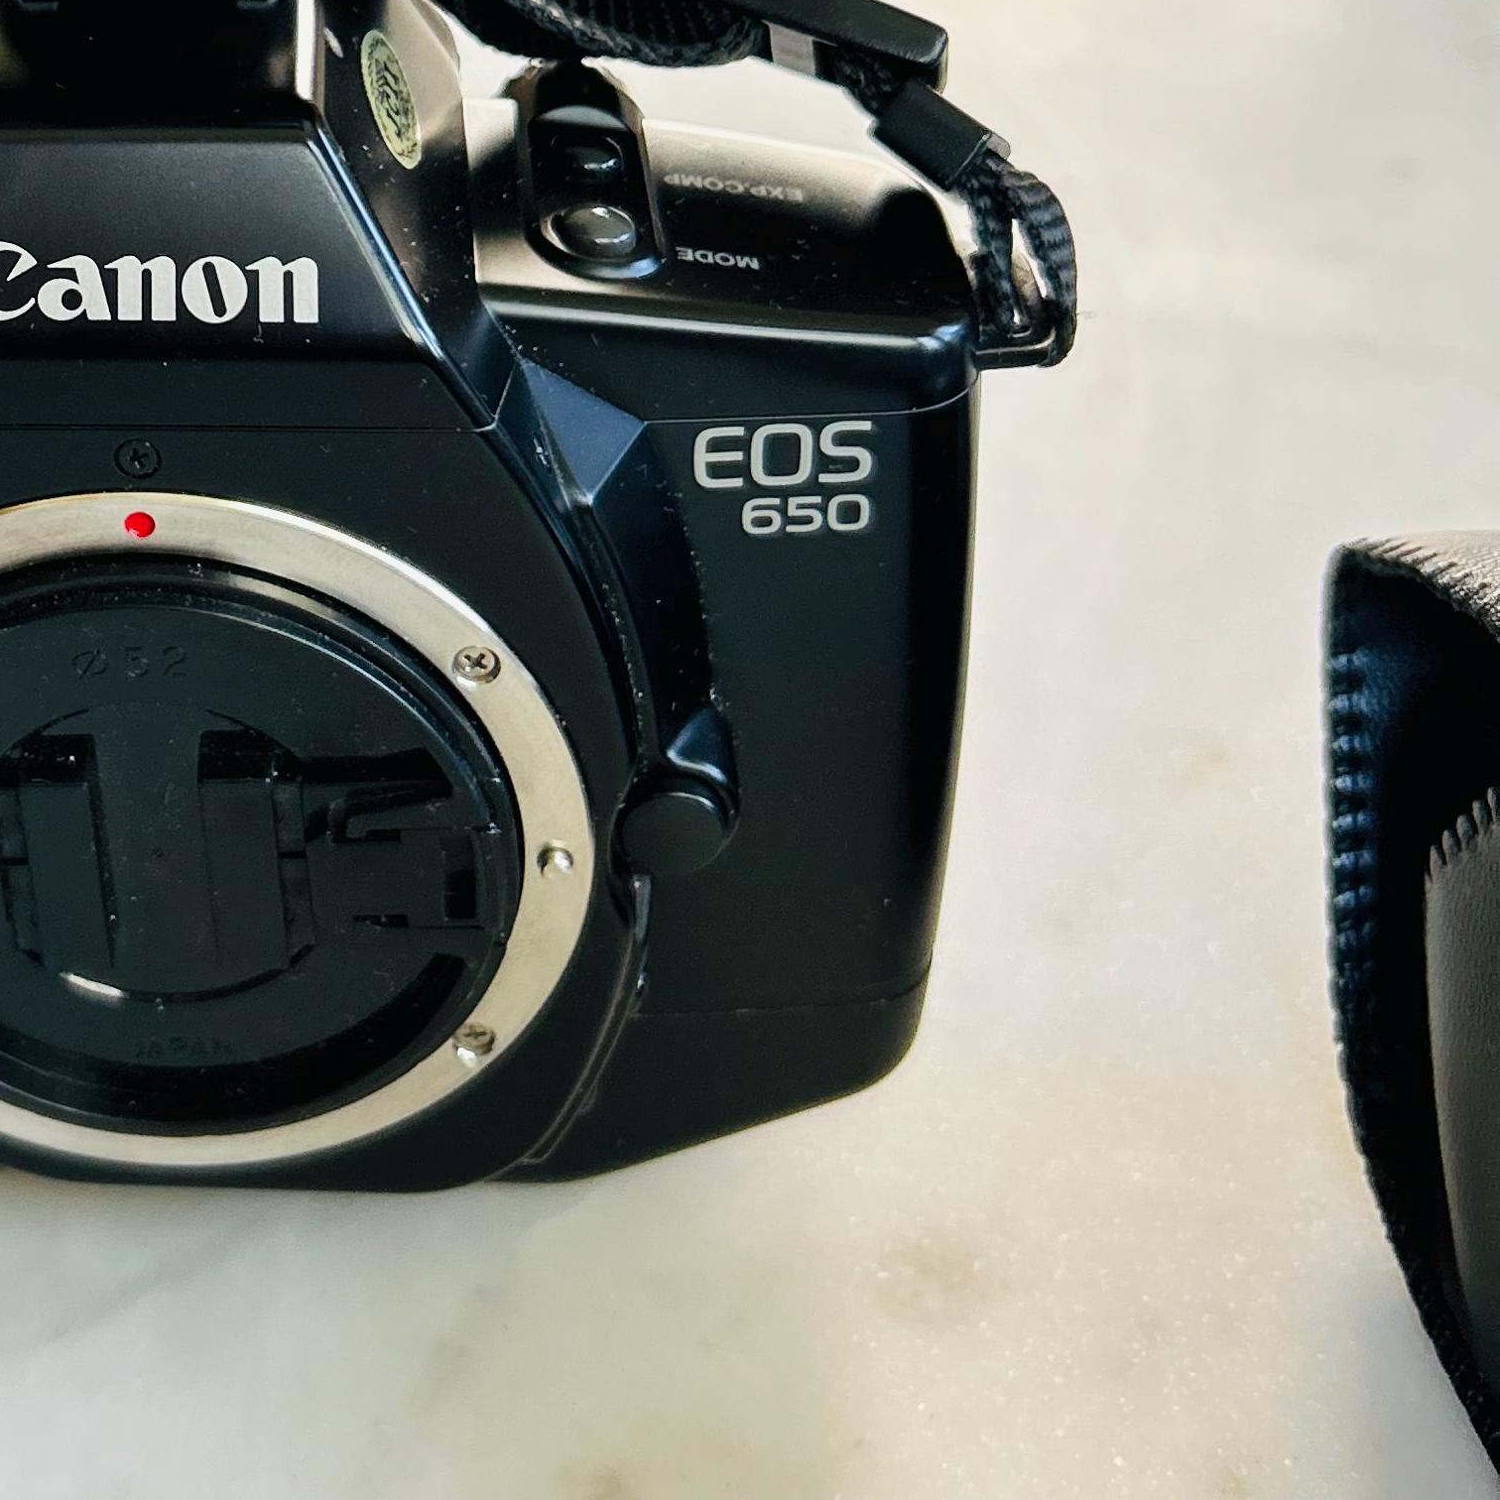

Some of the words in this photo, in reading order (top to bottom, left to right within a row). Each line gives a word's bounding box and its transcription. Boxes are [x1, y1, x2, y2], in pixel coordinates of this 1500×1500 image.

[675, 246, 760, 270] MODE
[693, 420, 874, 489] EOS
[742, 493, 871, 535] 650
